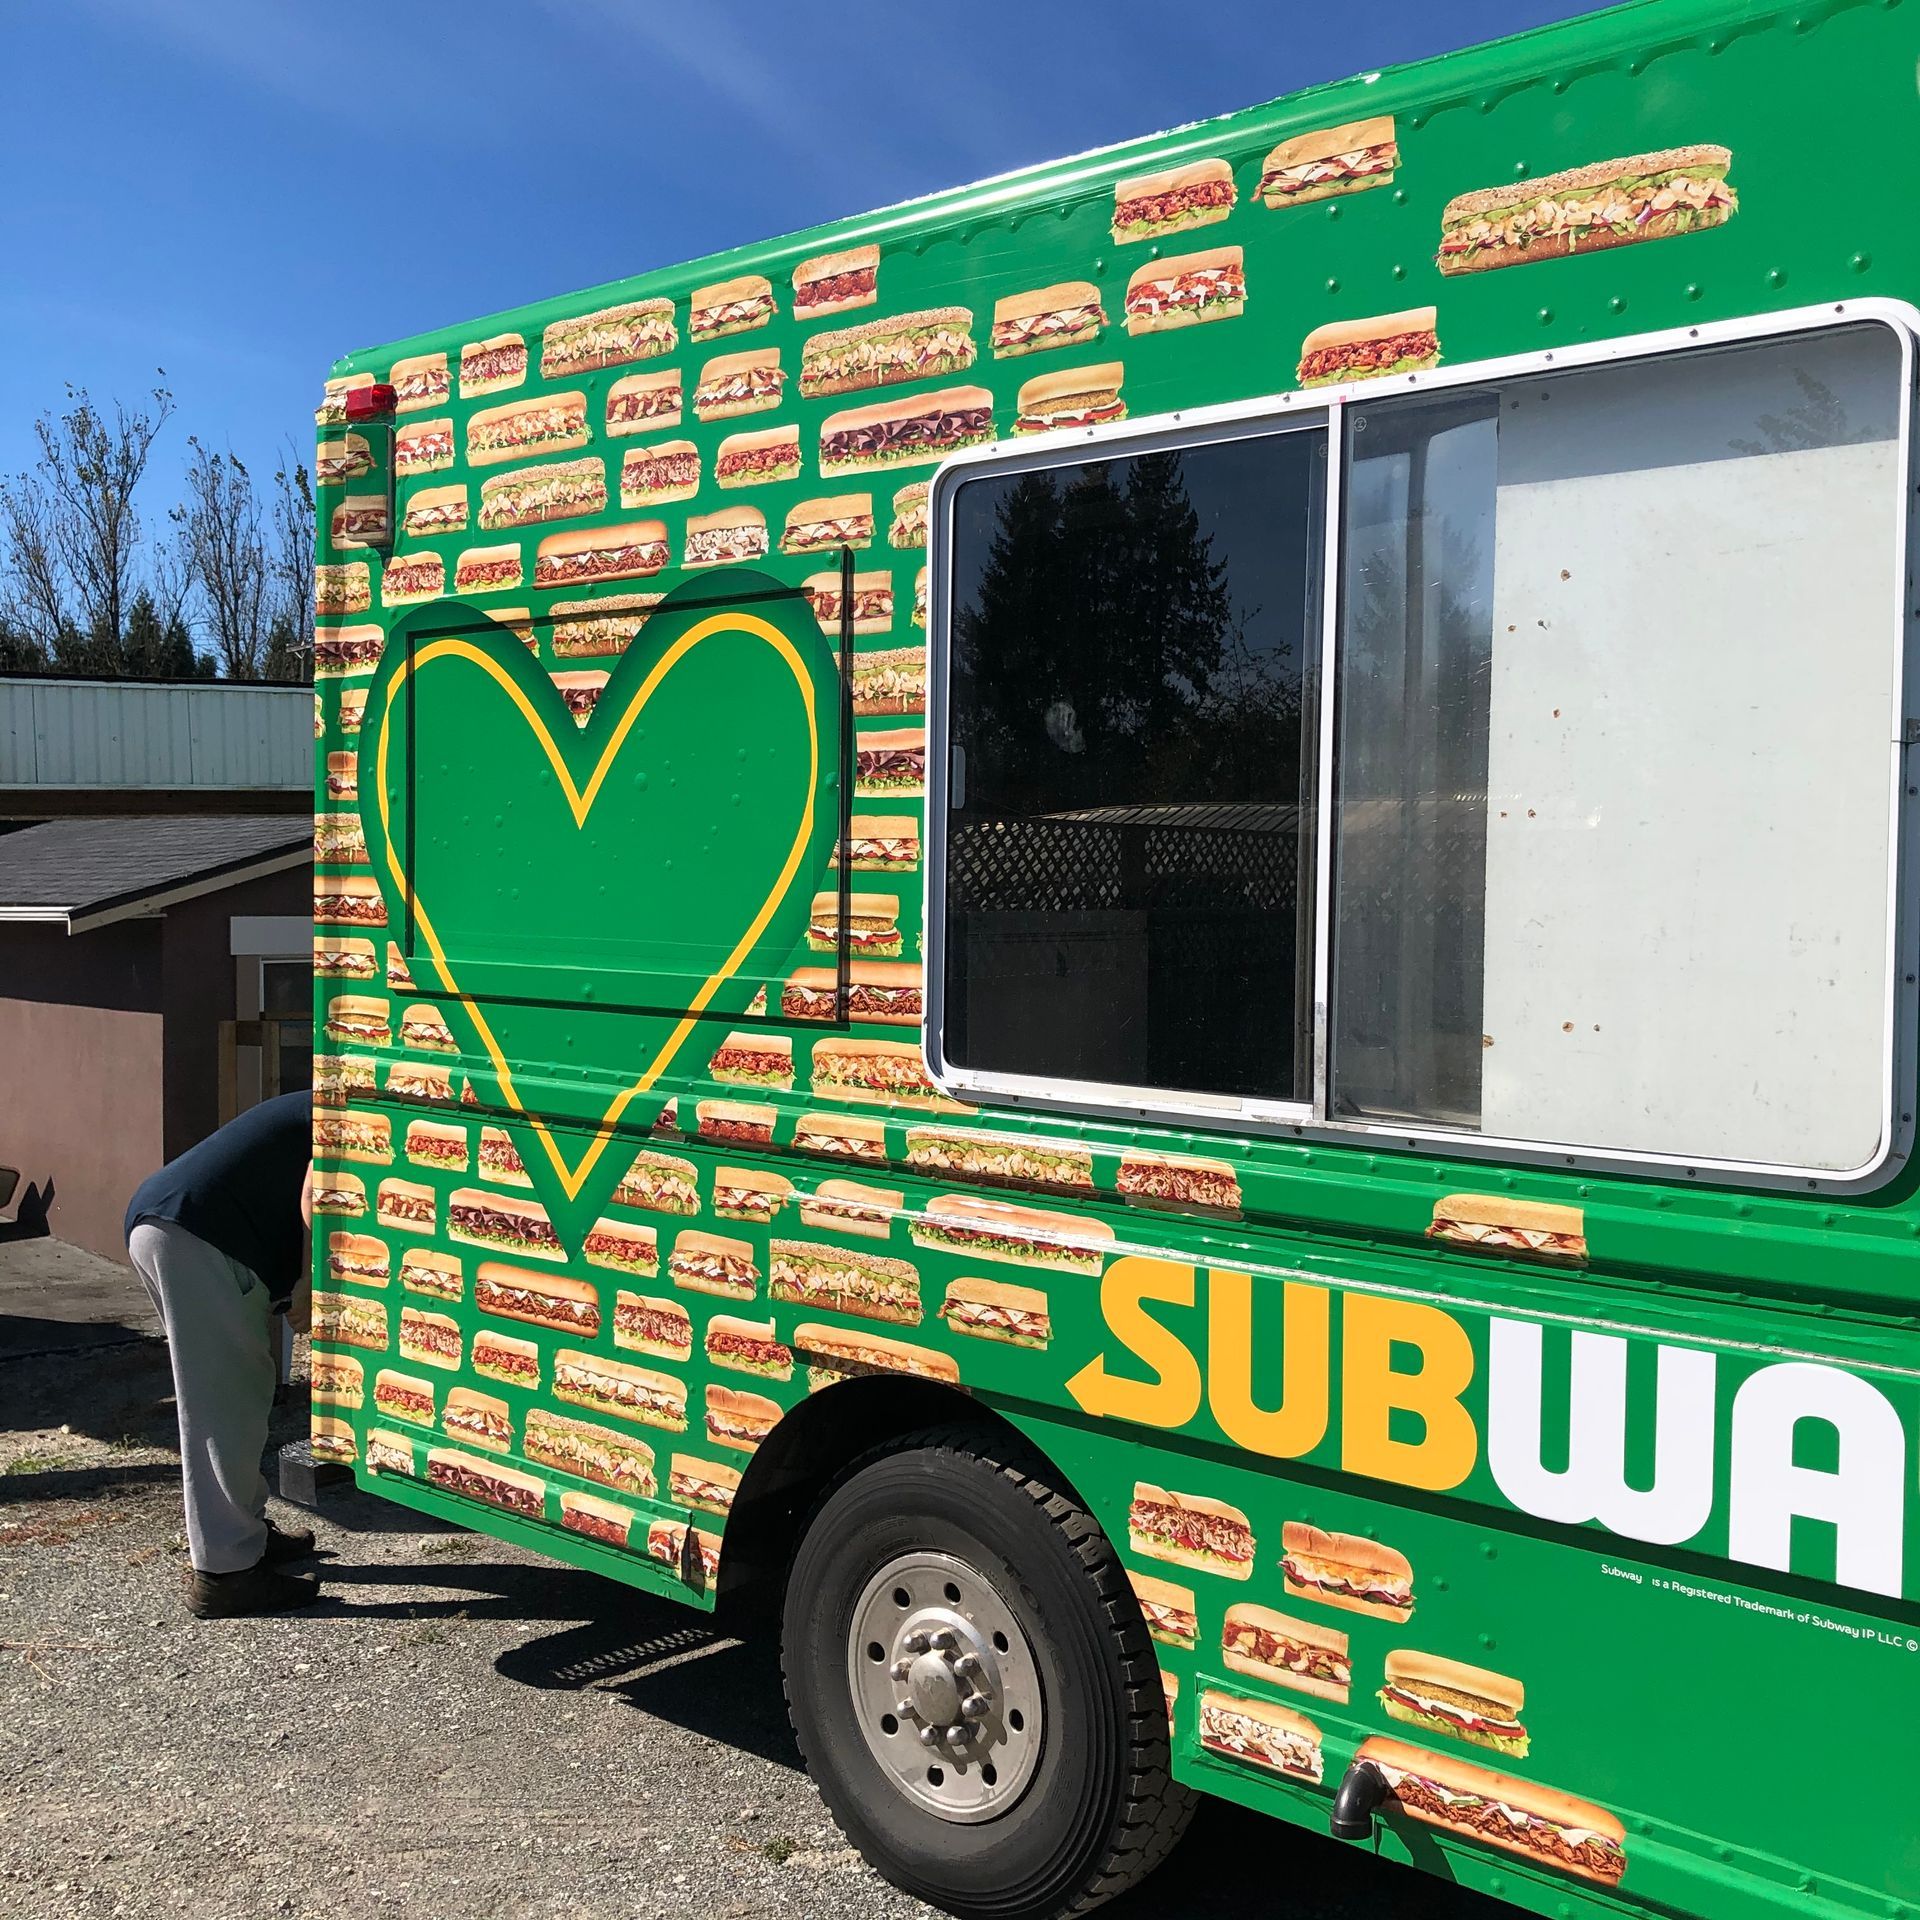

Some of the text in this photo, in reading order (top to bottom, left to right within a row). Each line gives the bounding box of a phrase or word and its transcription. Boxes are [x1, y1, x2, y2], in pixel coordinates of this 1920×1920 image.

[1065, 1256, 1920, 1599] SUBWA
[1601, 1563, 1643, 1584] Subway
[1652, 1578, 1661, 1588] is
[1662, 1580, 1670, 1589] a
[1672, 1581, 1732, 1604] Registered
[1733, 1595, 1795, 1620] Trademark
[1797, 1613, 1810, 1624] of
[1812, 1615, 1860, 1639] Subway
[1862, 1627, 1876, 1639] IP
[1878, 1632, 1903, 1647] LLC
